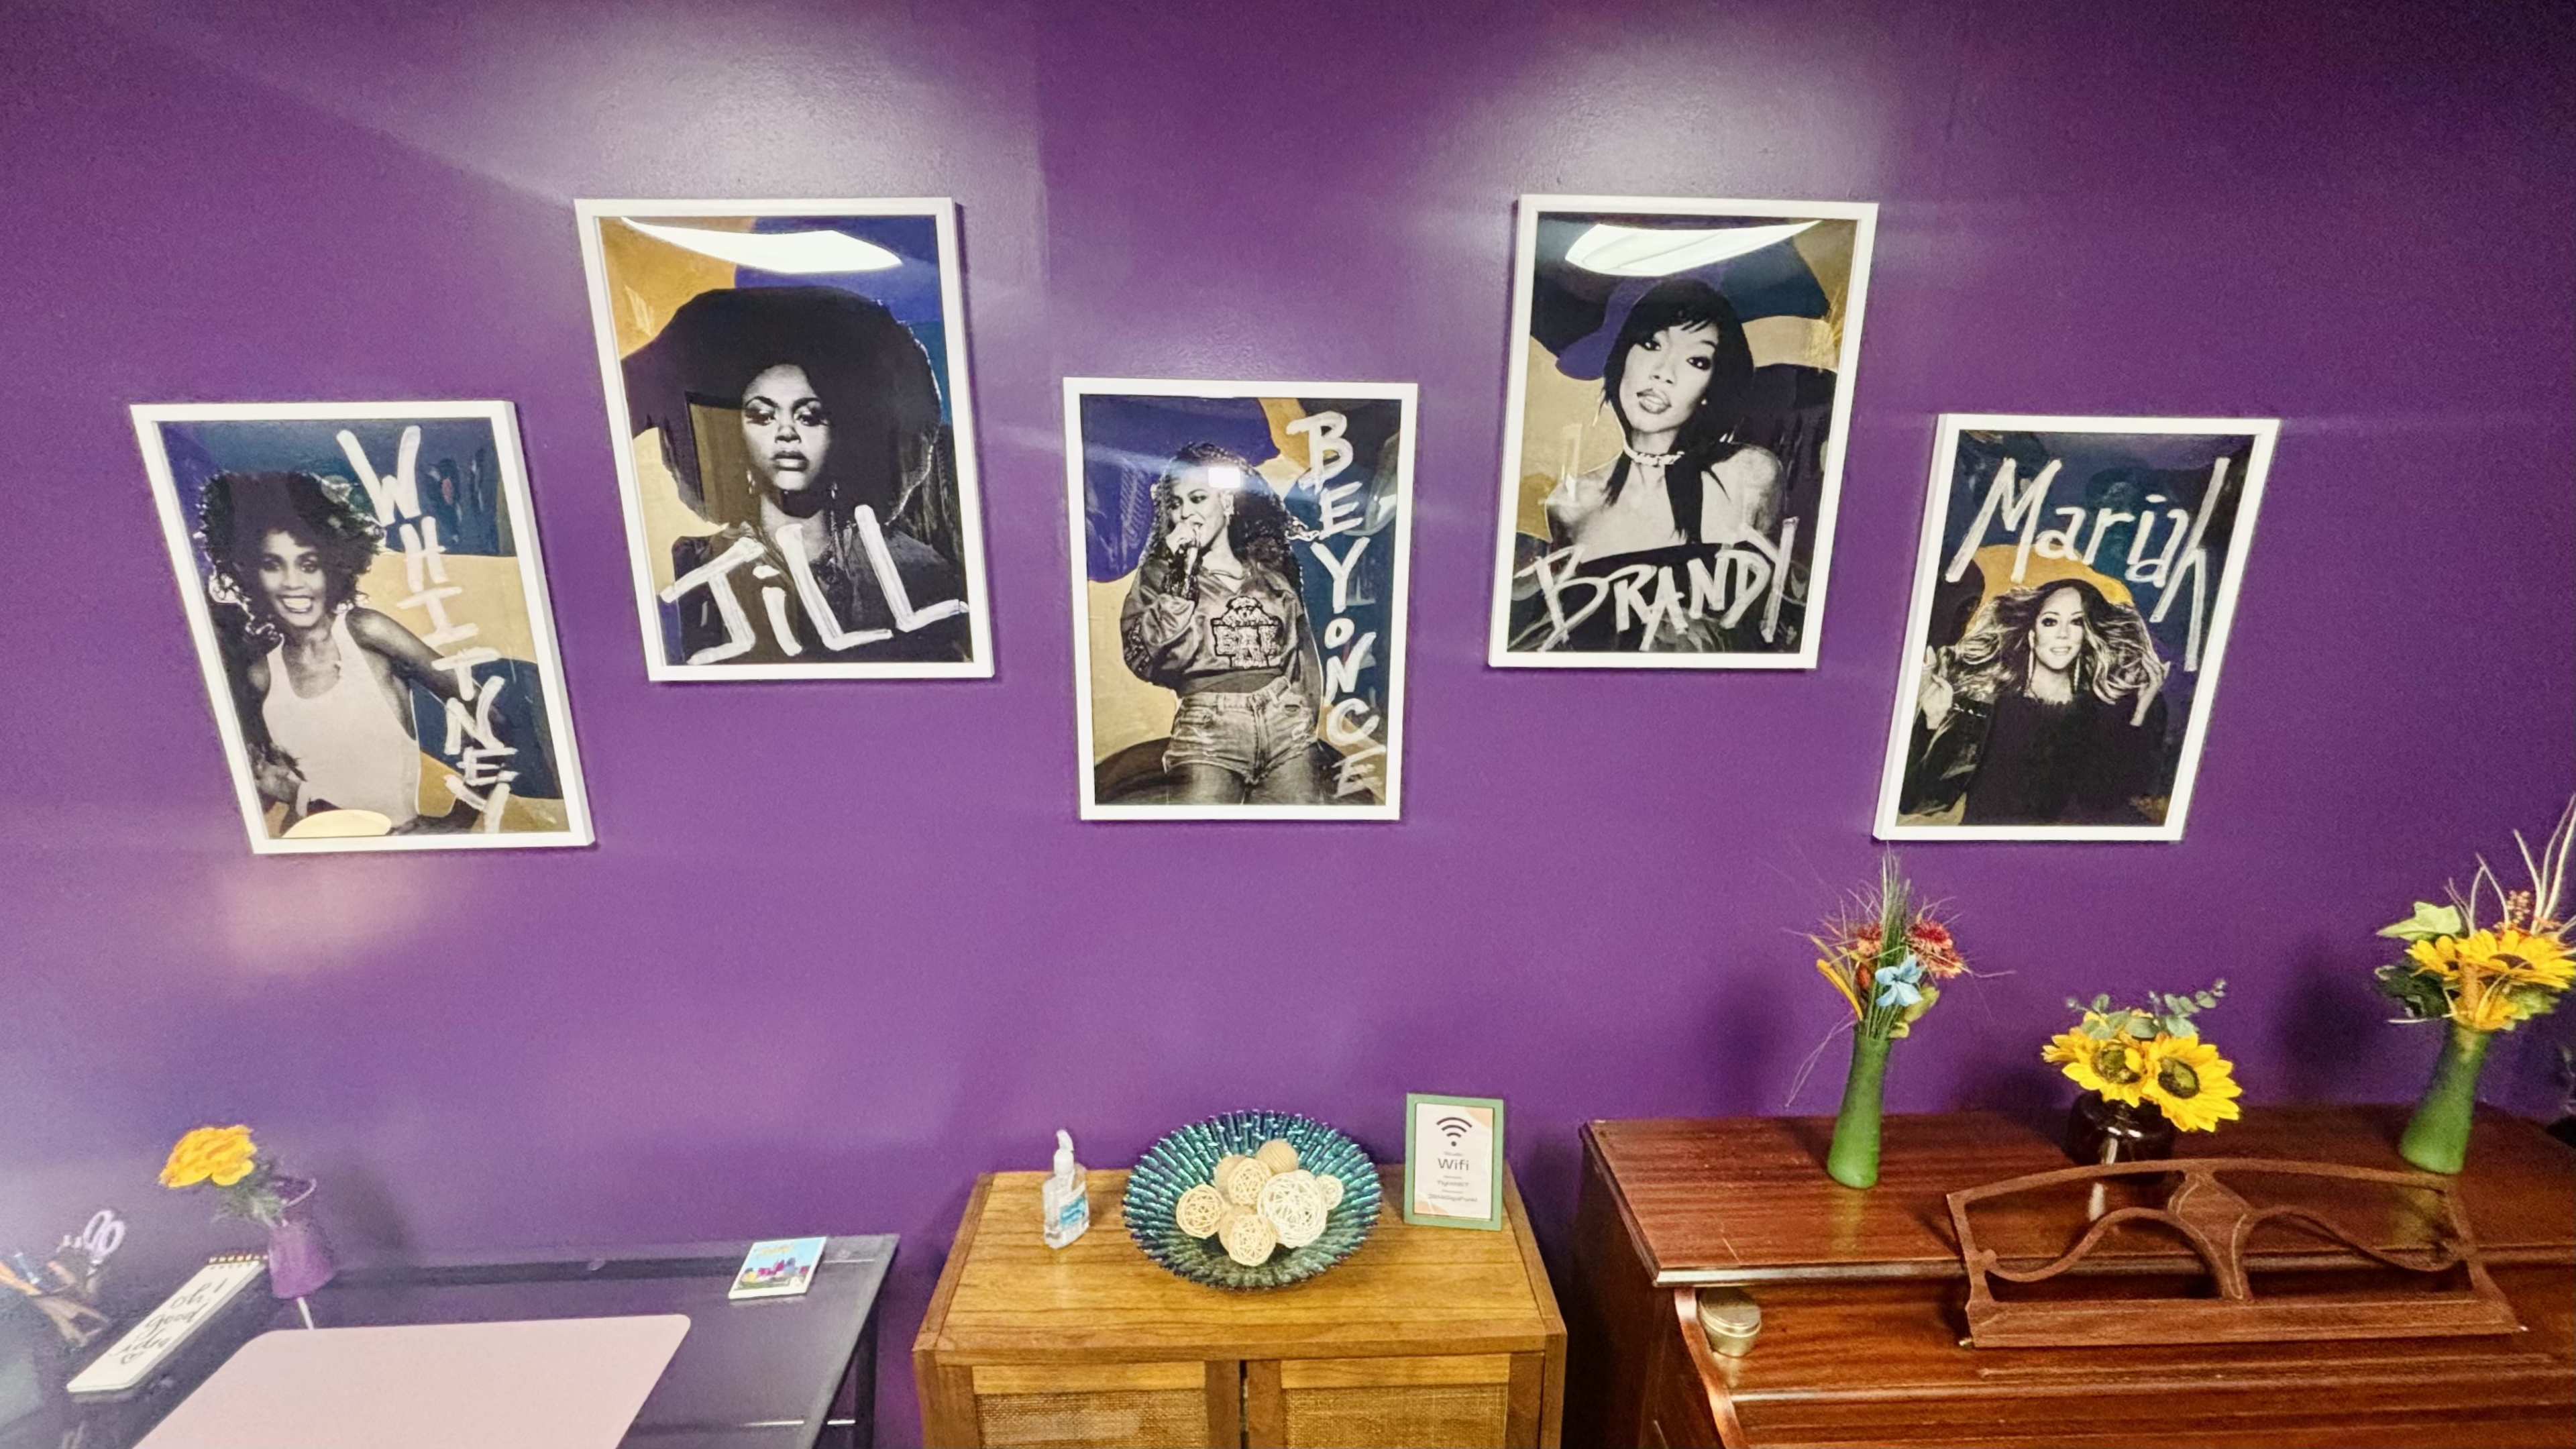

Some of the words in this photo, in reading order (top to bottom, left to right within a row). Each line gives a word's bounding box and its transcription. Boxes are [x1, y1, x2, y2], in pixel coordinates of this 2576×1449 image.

[1945, 458, 2231, 672] Mariah
[337, 425, 520, 834] WHITNEY
[1438, 1158, 1470, 1171] Wifi
[136, 1302, 209, 1340] good
